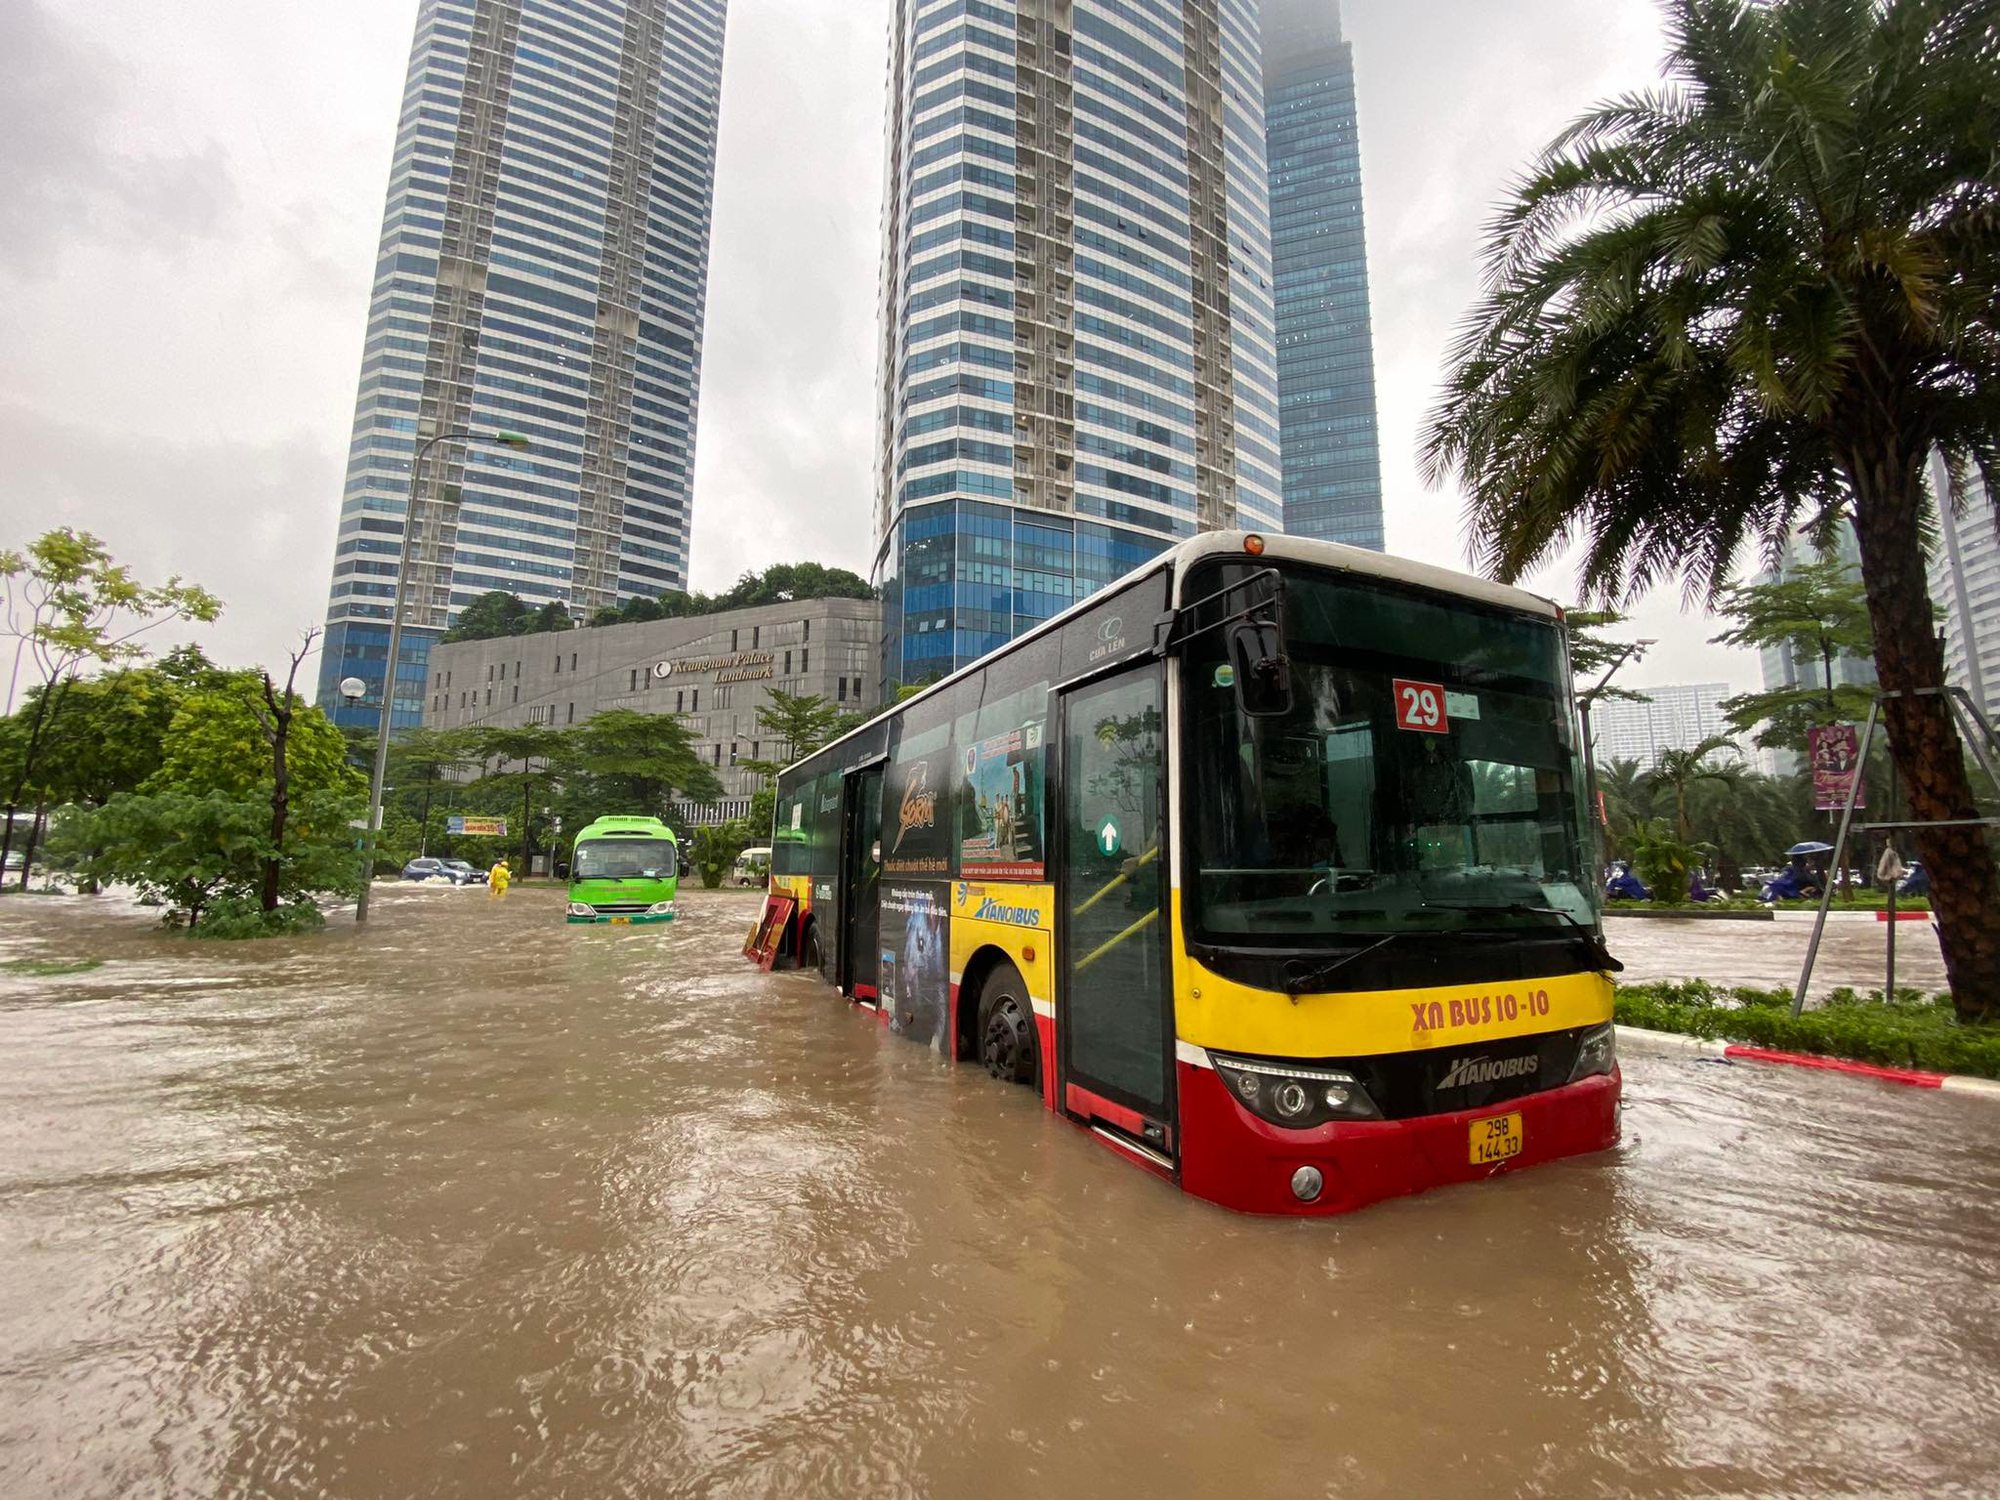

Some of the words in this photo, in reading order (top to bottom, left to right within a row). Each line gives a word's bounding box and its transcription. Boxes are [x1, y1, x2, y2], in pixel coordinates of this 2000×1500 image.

[674, 658, 733, 673] Keangnam
[735, 652, 774, 666] Palace
[714, 667, 773, 684] Landmark
[1402, 687, 1439, 727] 29
[974, 897, 1039, 925] HANOIBUS
[1449, 996, 1491, 1027] BUS
[1436, 1055, 1538, 1089] HANOIBUS
[1487, 1118, 1508, 1139] 29B
[1478, 1136, 1518, 1161] 144.33
